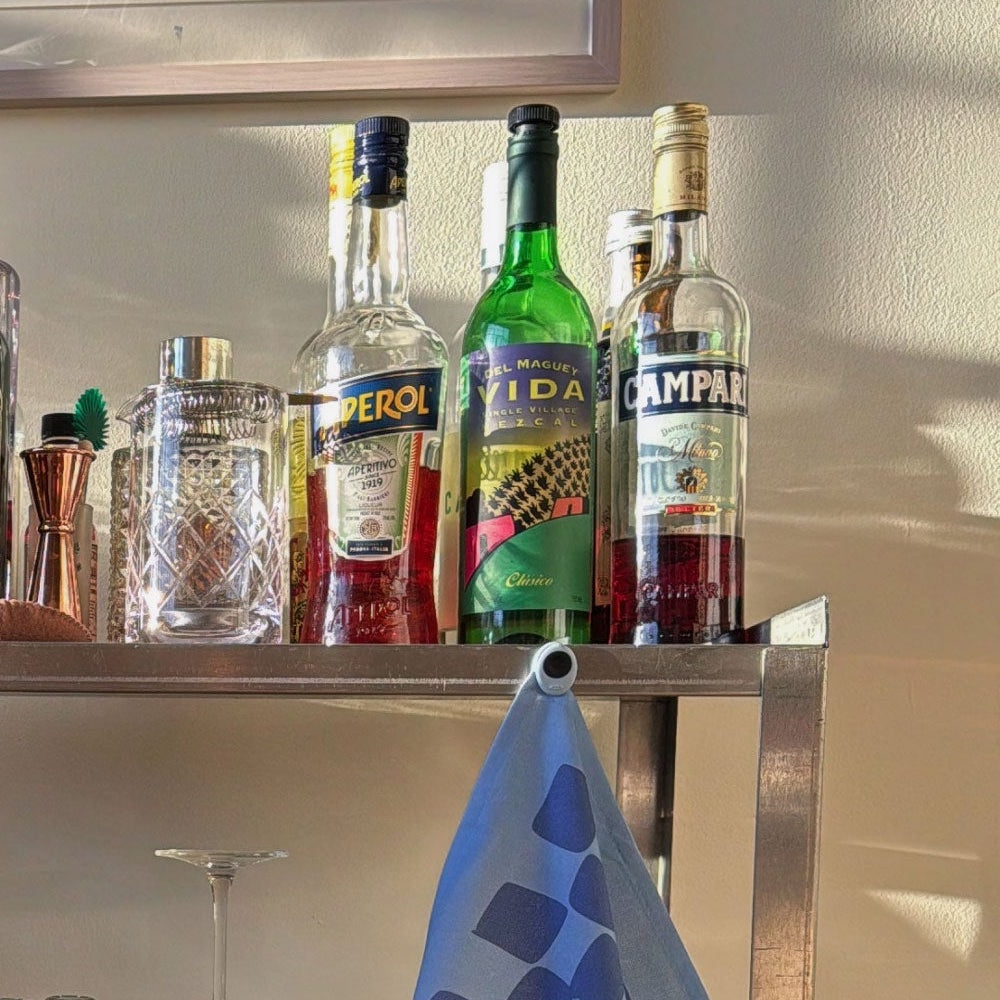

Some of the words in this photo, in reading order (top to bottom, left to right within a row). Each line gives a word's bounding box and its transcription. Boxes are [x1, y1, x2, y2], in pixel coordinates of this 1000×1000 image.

[517, 359, 578, 376] MAGUEY
[477, 378, 584, 405] VIDA
[319, 385, 429, 440] PEROL
[486, 407, 522, 417] INGLE
[529, 406, 577, 414] VILLAGE
[487, 418, 577, 429] EZCAL
[347, 459, 397, 478] APERITIVO
[361, 478, 383, 490] 1919
